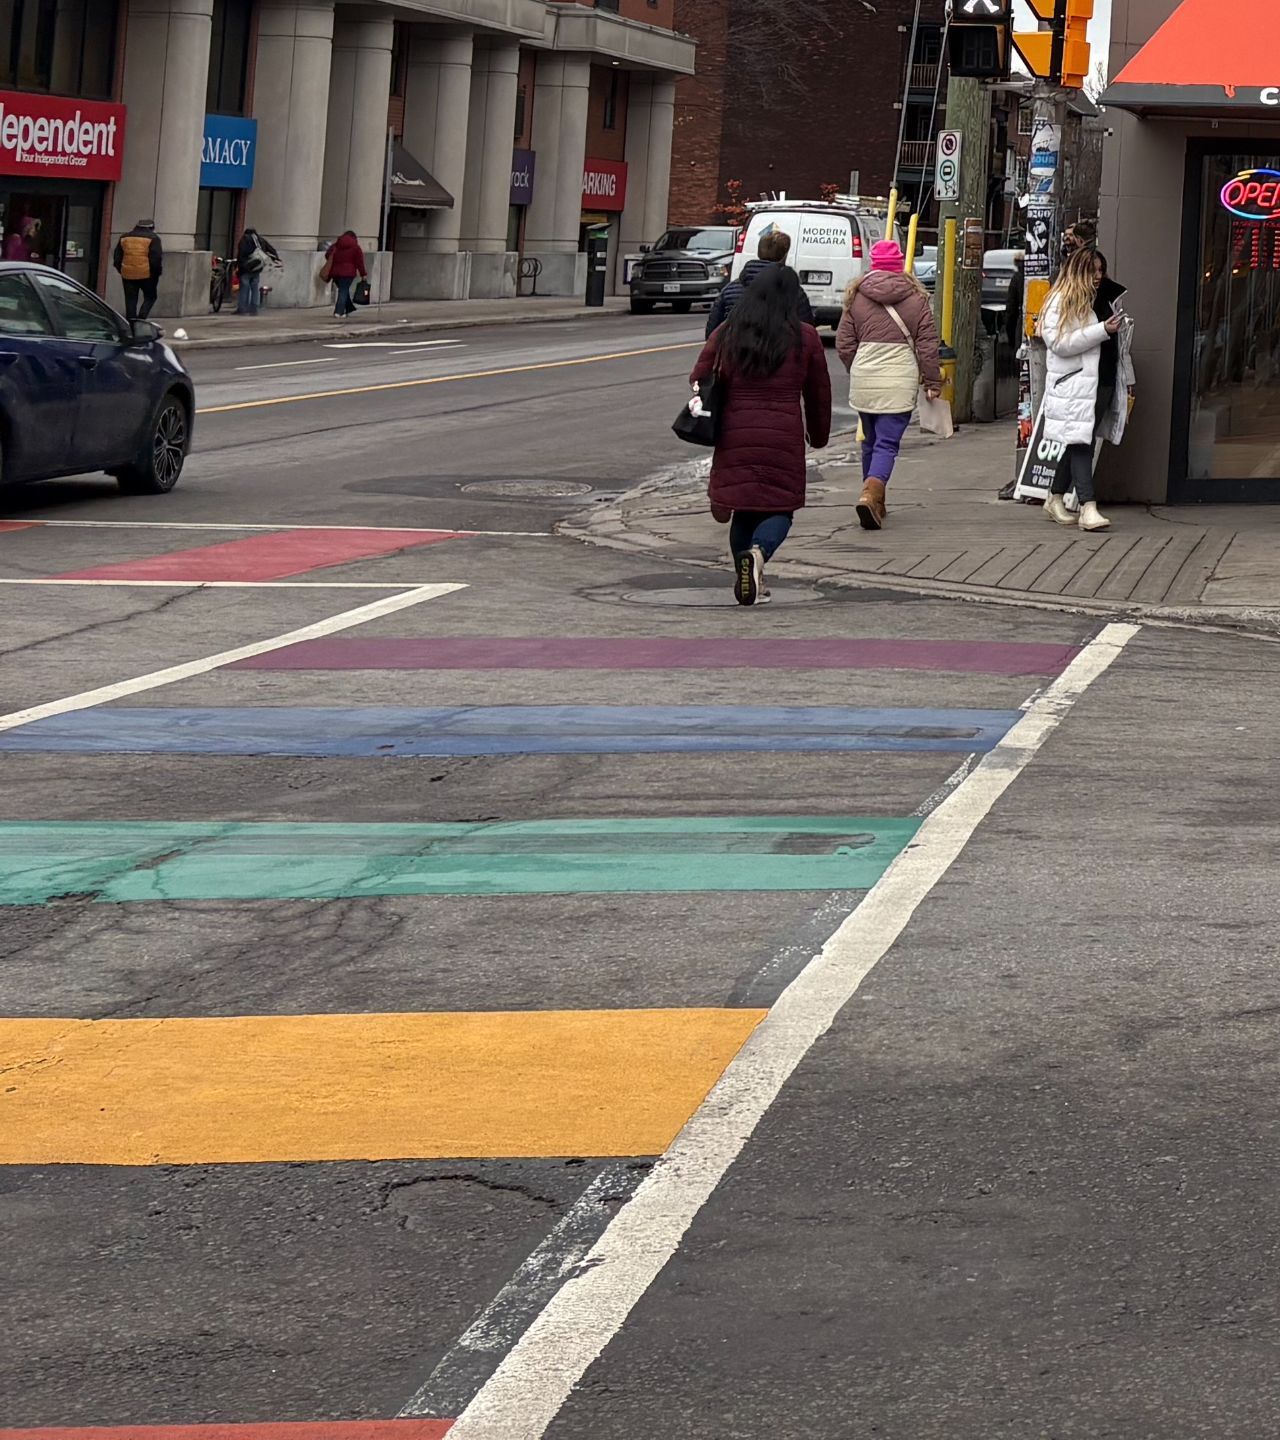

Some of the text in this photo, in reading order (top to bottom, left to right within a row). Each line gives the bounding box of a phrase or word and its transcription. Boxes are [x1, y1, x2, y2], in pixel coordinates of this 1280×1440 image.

[0, 102, 117, 162] ependent
[803, 227, 847, 237] MODERN
[802, 236, 846, 246] NIAGARA
